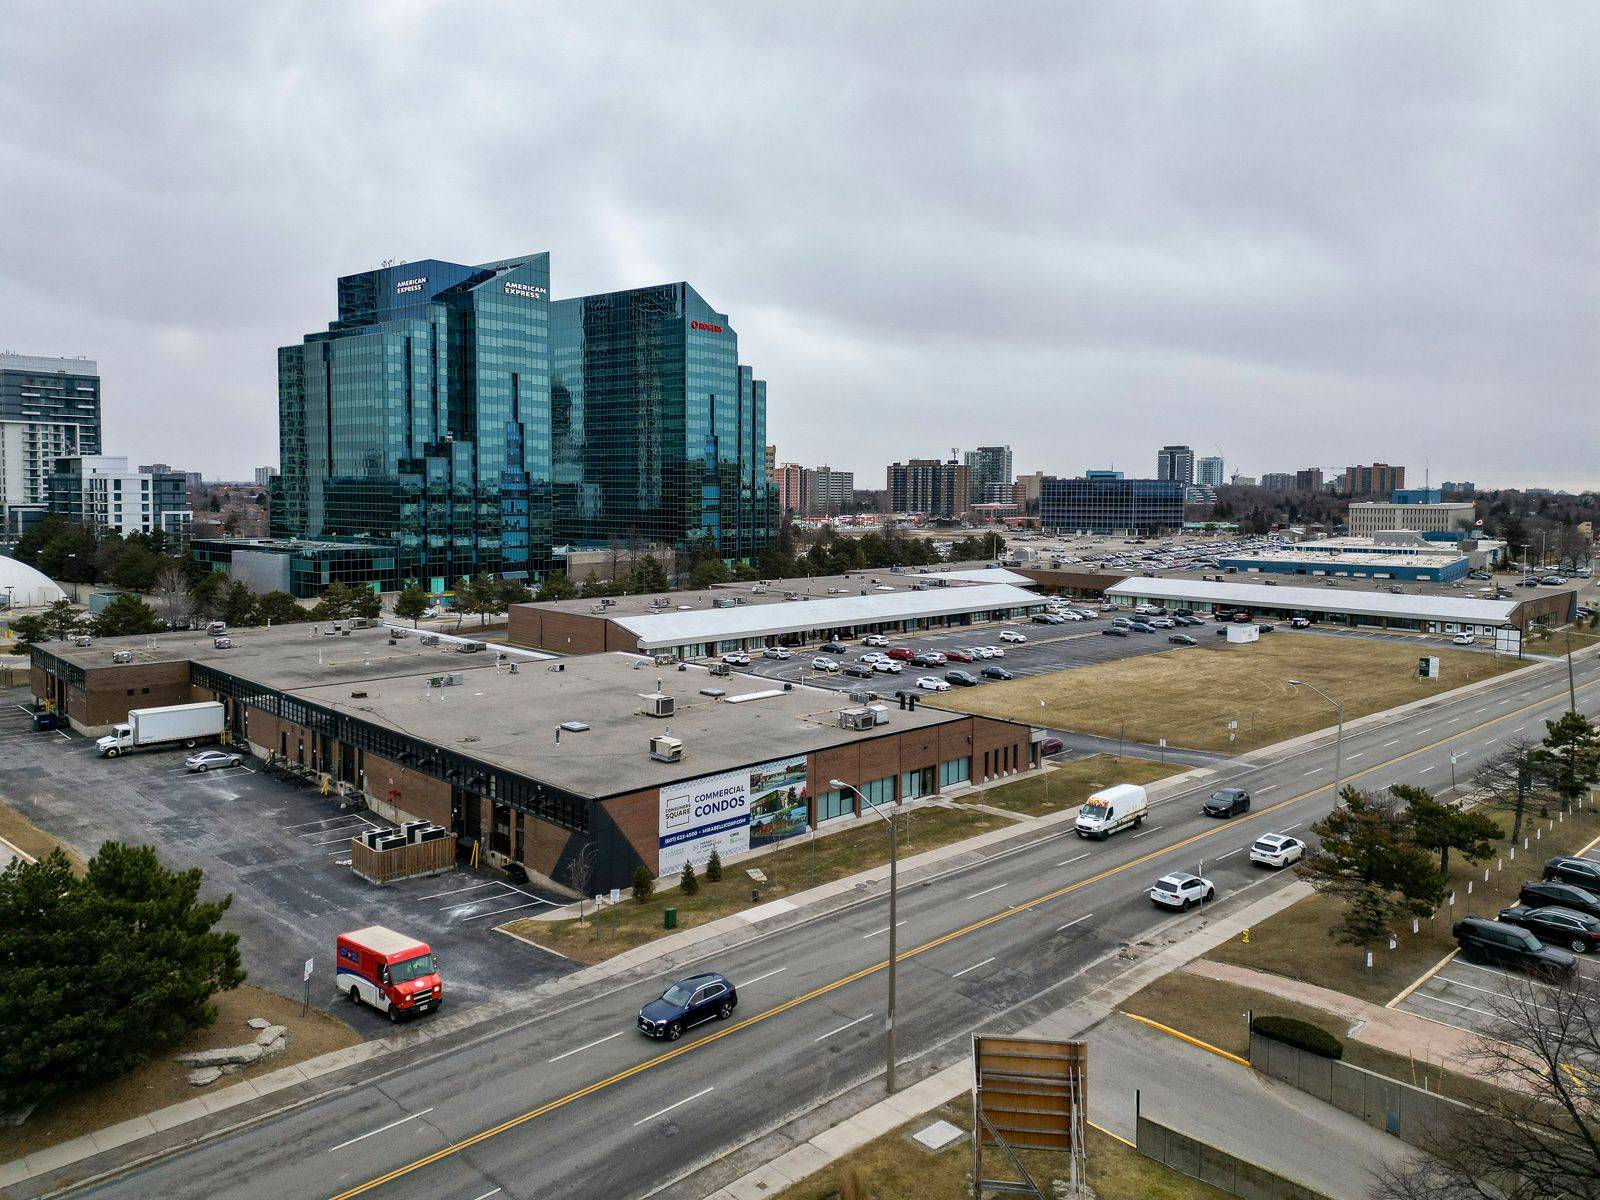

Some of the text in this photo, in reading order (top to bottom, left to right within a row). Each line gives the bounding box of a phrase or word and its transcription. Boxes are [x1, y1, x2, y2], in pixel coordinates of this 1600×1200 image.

[397, 277, 427, 287] AMERICAN
[505, 281, 546, 293] AMERICAN
[397, 284, 422, 293] EXPRESS
[505, 287, 540, 299] EXPRESS
[698, 322, 723, 333] ROGERS
[694, 785, 745, 803] COMMERCIAL
[694, 795, 746, 818] CONDOS
[665, 807, 691, 820] SQUARE
